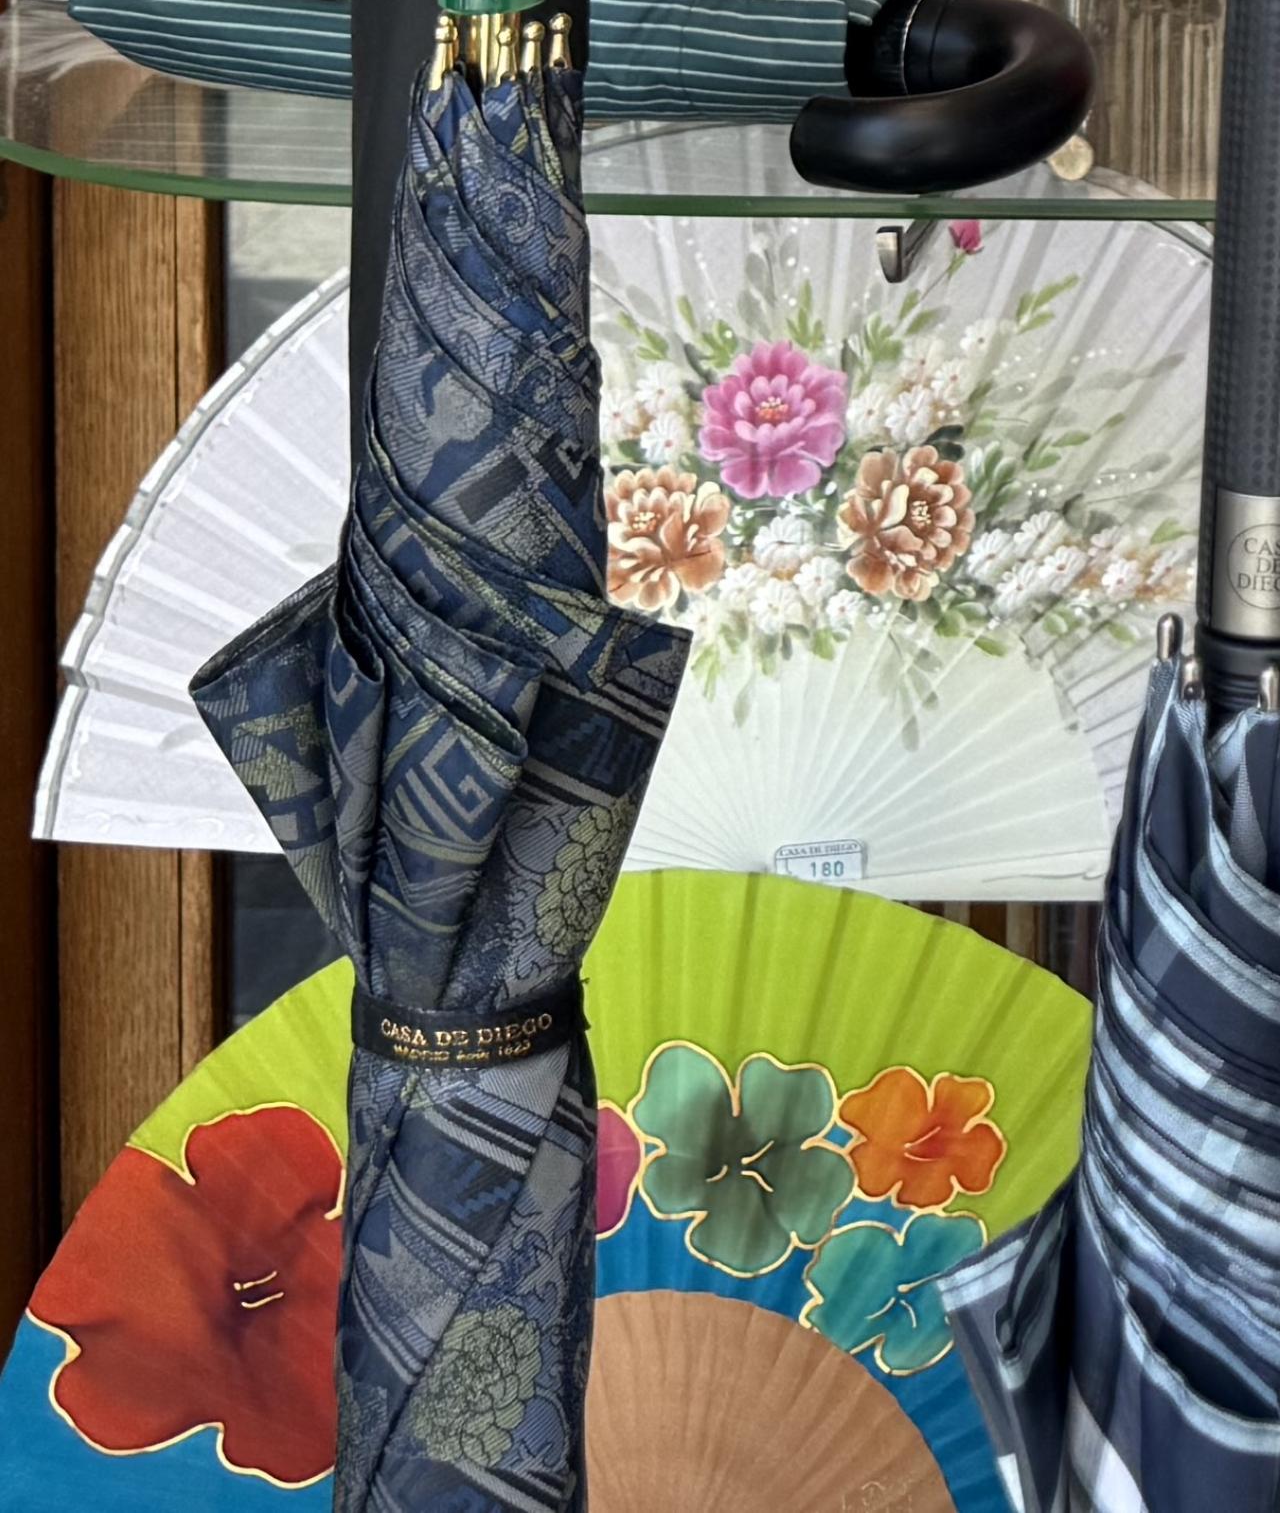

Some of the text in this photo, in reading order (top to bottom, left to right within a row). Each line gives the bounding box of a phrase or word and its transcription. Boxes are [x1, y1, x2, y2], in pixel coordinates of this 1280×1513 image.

[810, 860, 845, 878] 180
[381, 1012, 553, 1047] CASA DE DIEGO
